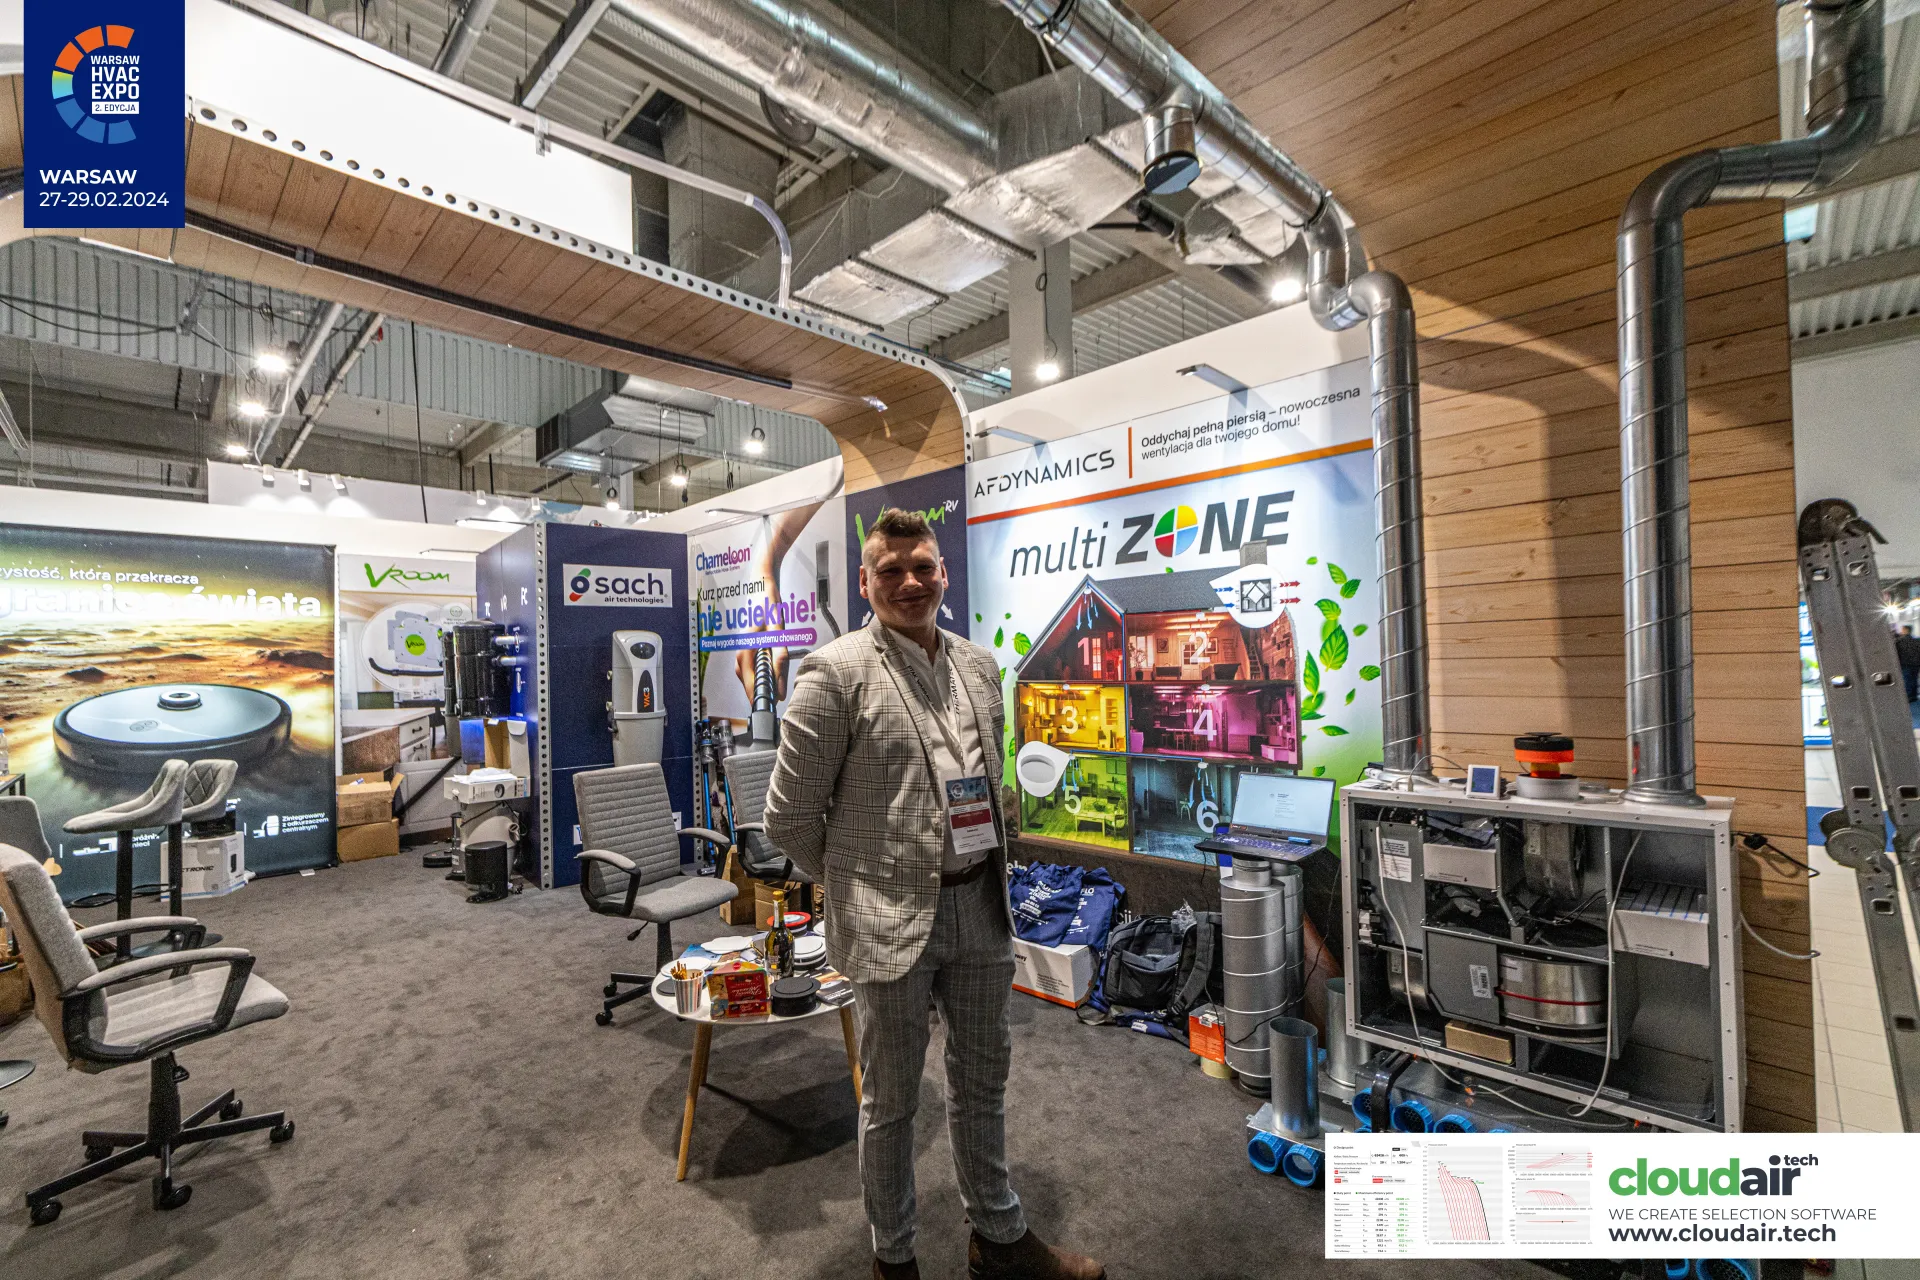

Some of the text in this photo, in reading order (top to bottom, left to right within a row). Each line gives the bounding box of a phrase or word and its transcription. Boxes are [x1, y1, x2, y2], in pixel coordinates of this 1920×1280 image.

[1141, 427, 1191, 449] Oddychaj
[1193, 419, 1224, 438] pełną
[1226, 409, 1266, 431] piersią
[1279, 386, 1361, 415] nowoczesna
[1141, 414, 1301, 460] wentylacja dla twojego domu!
[974, 449, 1115, 499] AFDYNAMICS
[1009, 490, 1295, 578] multi ZONE
[696, 546, 750, 571] Chameleon
[69, 567, 111, 581] która
[115, 572, 199, 585] przekracza
[595, 573, 664, 595] sach
[698, 576, 765, 602] Kurz przed nami
[617, 596, 664, 604] technologies
[698, 592, 816, 632] nie ucieknie!
[779, 633, 812, 643] chowanego
[1077, 637, 1091, 666] 1
[1188, 632, 1211, 663] 2
[1061, 705, 1079, 735] 3
[1193, 709, 1217, 742] 4
[1064, 787, 1082, 815] 5
[1196, 800, 1221, 833] 6
